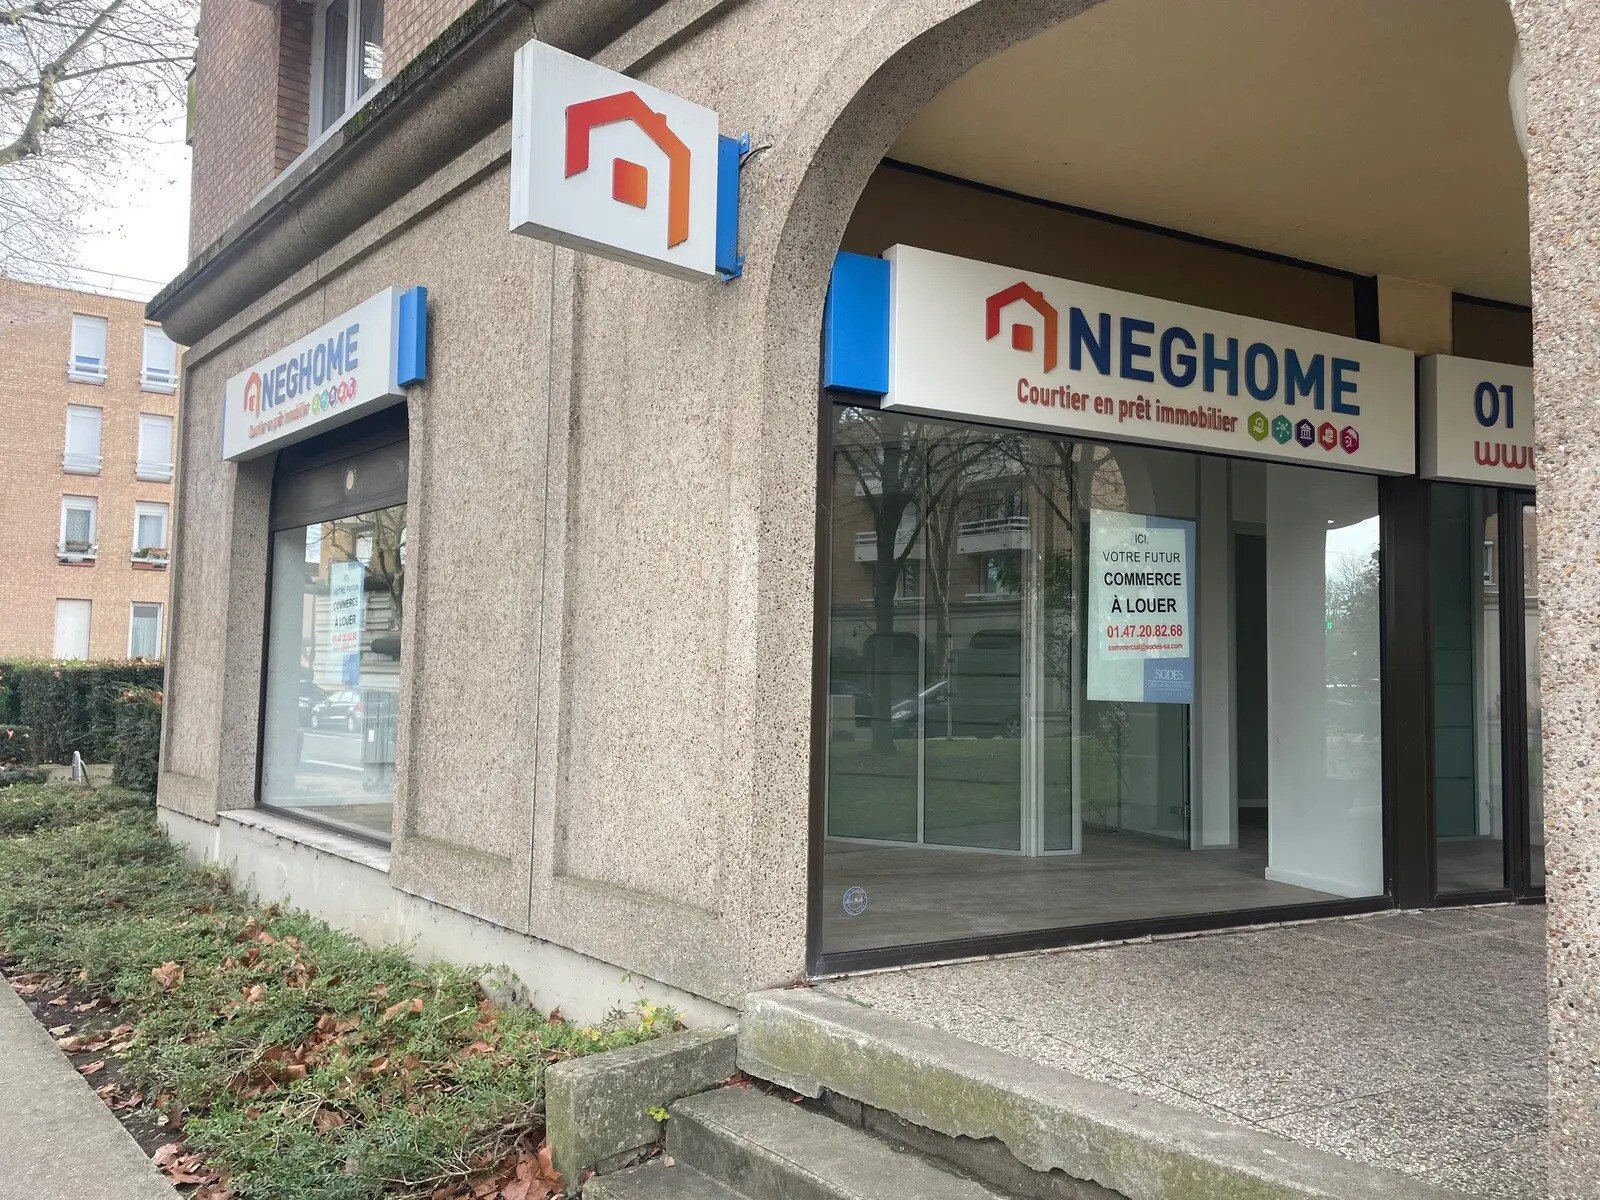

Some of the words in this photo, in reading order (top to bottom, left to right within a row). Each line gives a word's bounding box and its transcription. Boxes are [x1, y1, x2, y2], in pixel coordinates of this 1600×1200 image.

[262, 323, 359, 411] NEGHOME
[1069, 306, 1360, 416] NEGHOME
[1017, 377, 1089, 411] Courtier
[1093, 395, 1113, 415] en
[1118, 395, 1151, 422] prêt
[1155, 399, 1238, 432] immobilier
[1474, 381, 1514, 428] 01
[1134, 533, 1149, 545] ICI,
[1102, 551, 1140, 562] VOTRE
[1144, 552, 1181, 563] FUTUR
[1104, 572, 1182, 586] COMMERCE
[1111, 594, 1123, 613] À
[1126, 598, 1177, 613] LOUER
[339, 614, 357, 627] LOUER
[1107, 624, 1183, 638] 01.47.20.82.68
[1108, 642, 1183, 651] commercial@sodes-sa.com
[1154, 668, 1184, 681] SODES
